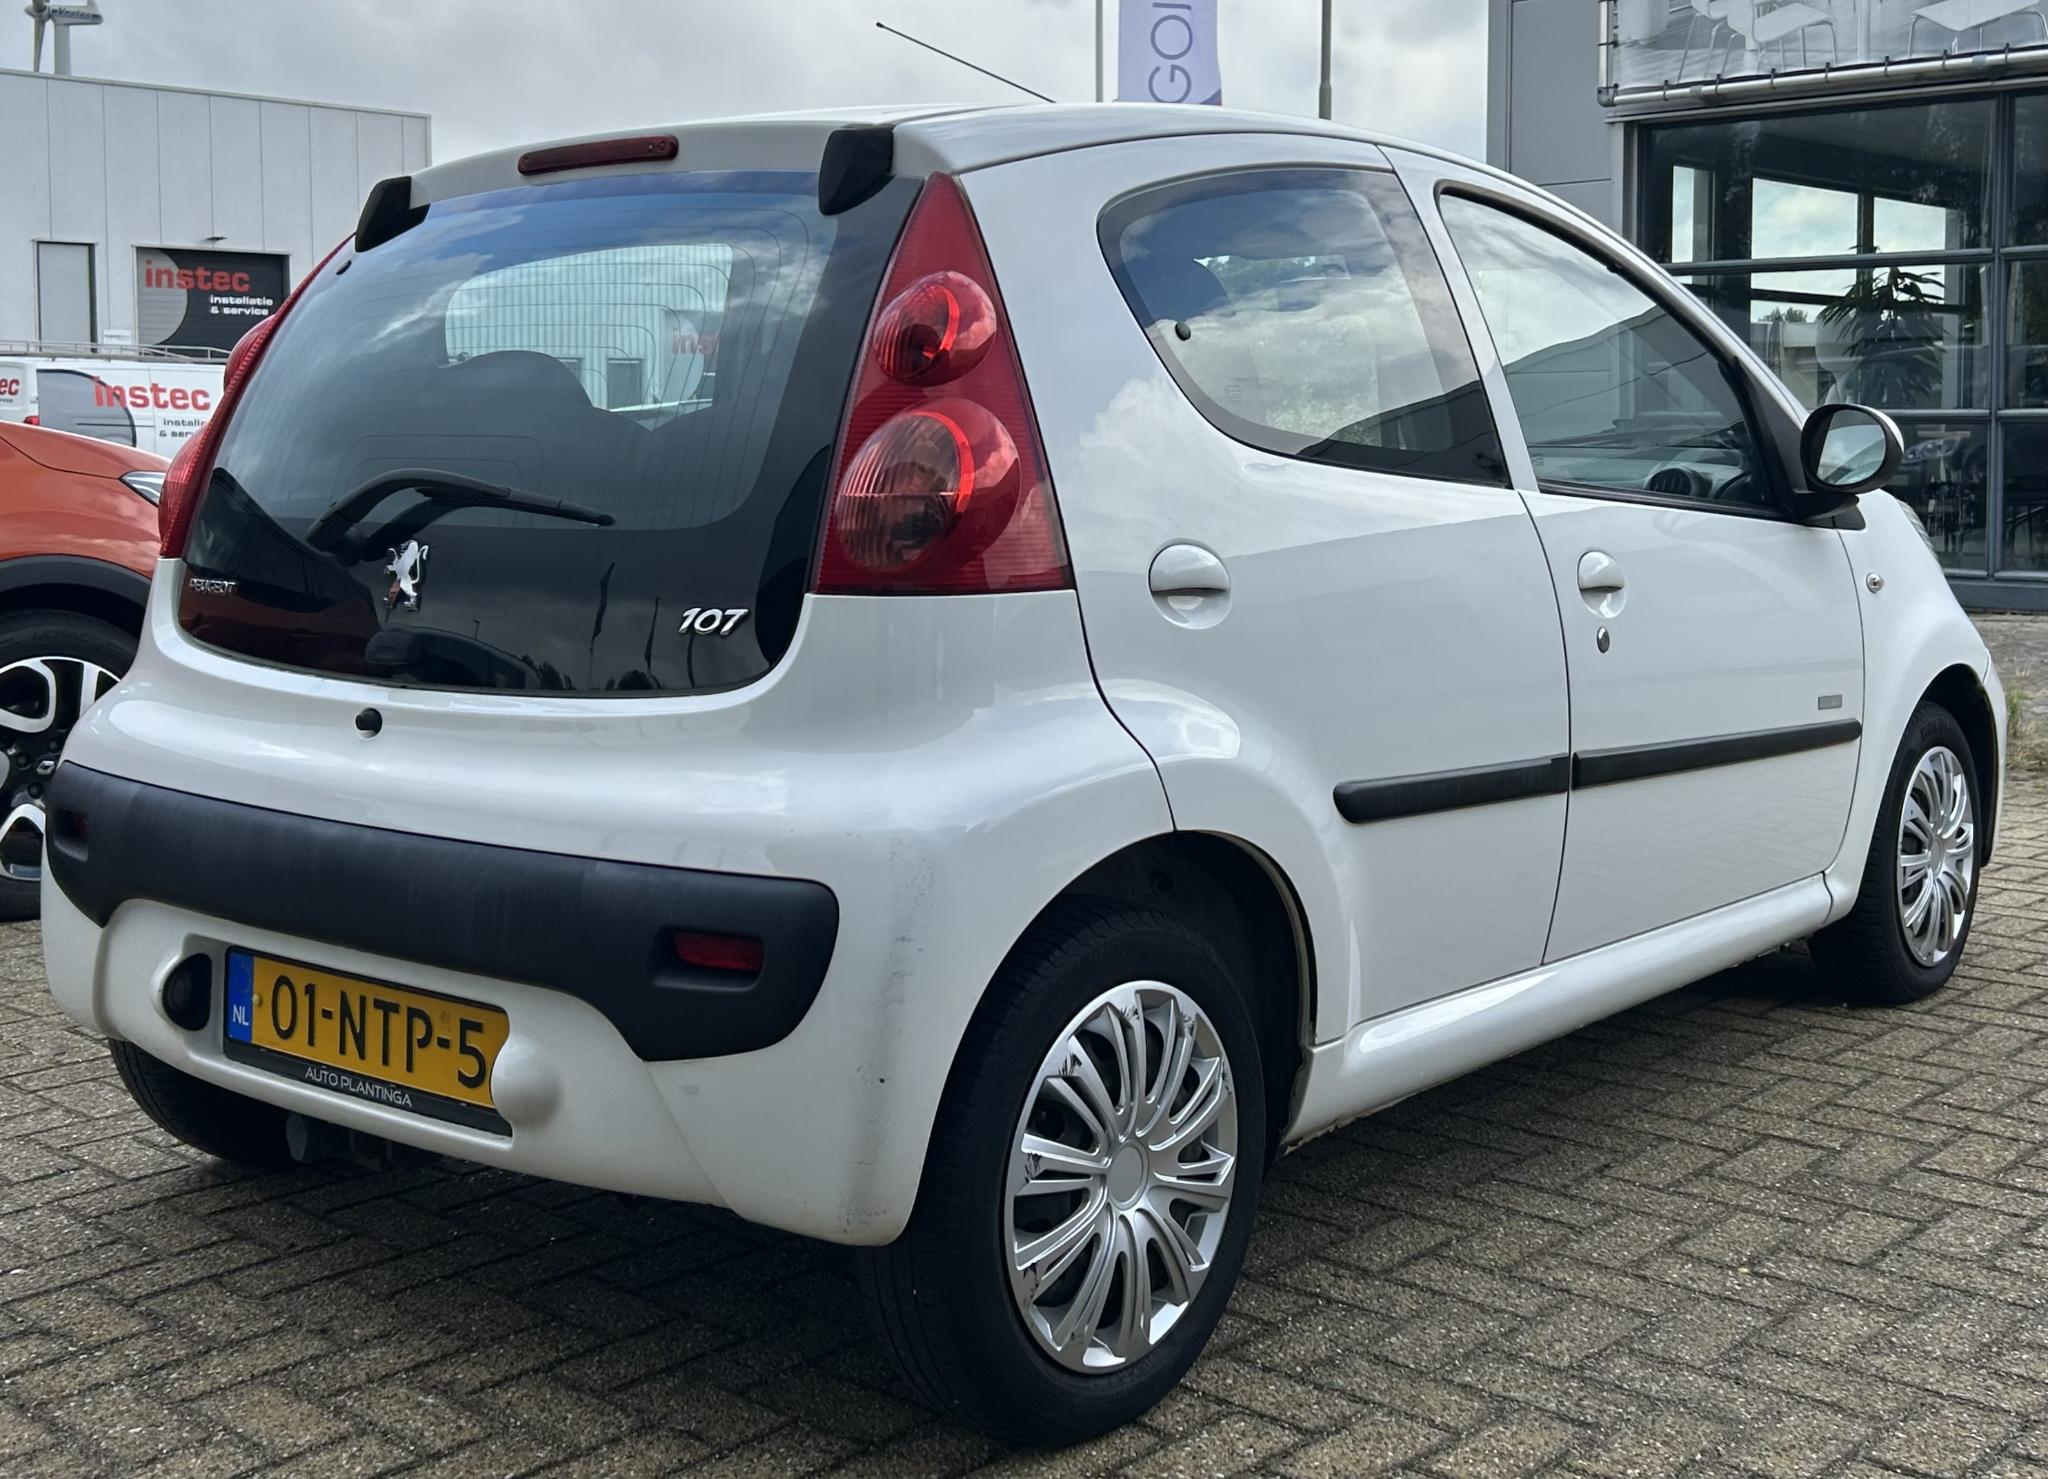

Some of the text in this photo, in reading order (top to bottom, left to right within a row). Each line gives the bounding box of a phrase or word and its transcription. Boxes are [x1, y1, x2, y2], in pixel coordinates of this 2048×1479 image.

[145, 260, 250, 293] instec
[210, 294, 274, 306] installatie
[210, 306, 269, 316] & service
[93, 376, 211, 412] instec
[679, 607, 749, 635] 107
[233, 1006, 249, 1026] NL
[271, 974, 487, 1089] 01-NTP-5
[305, 1067, 412, 1108] AUTO PLANTINGA
